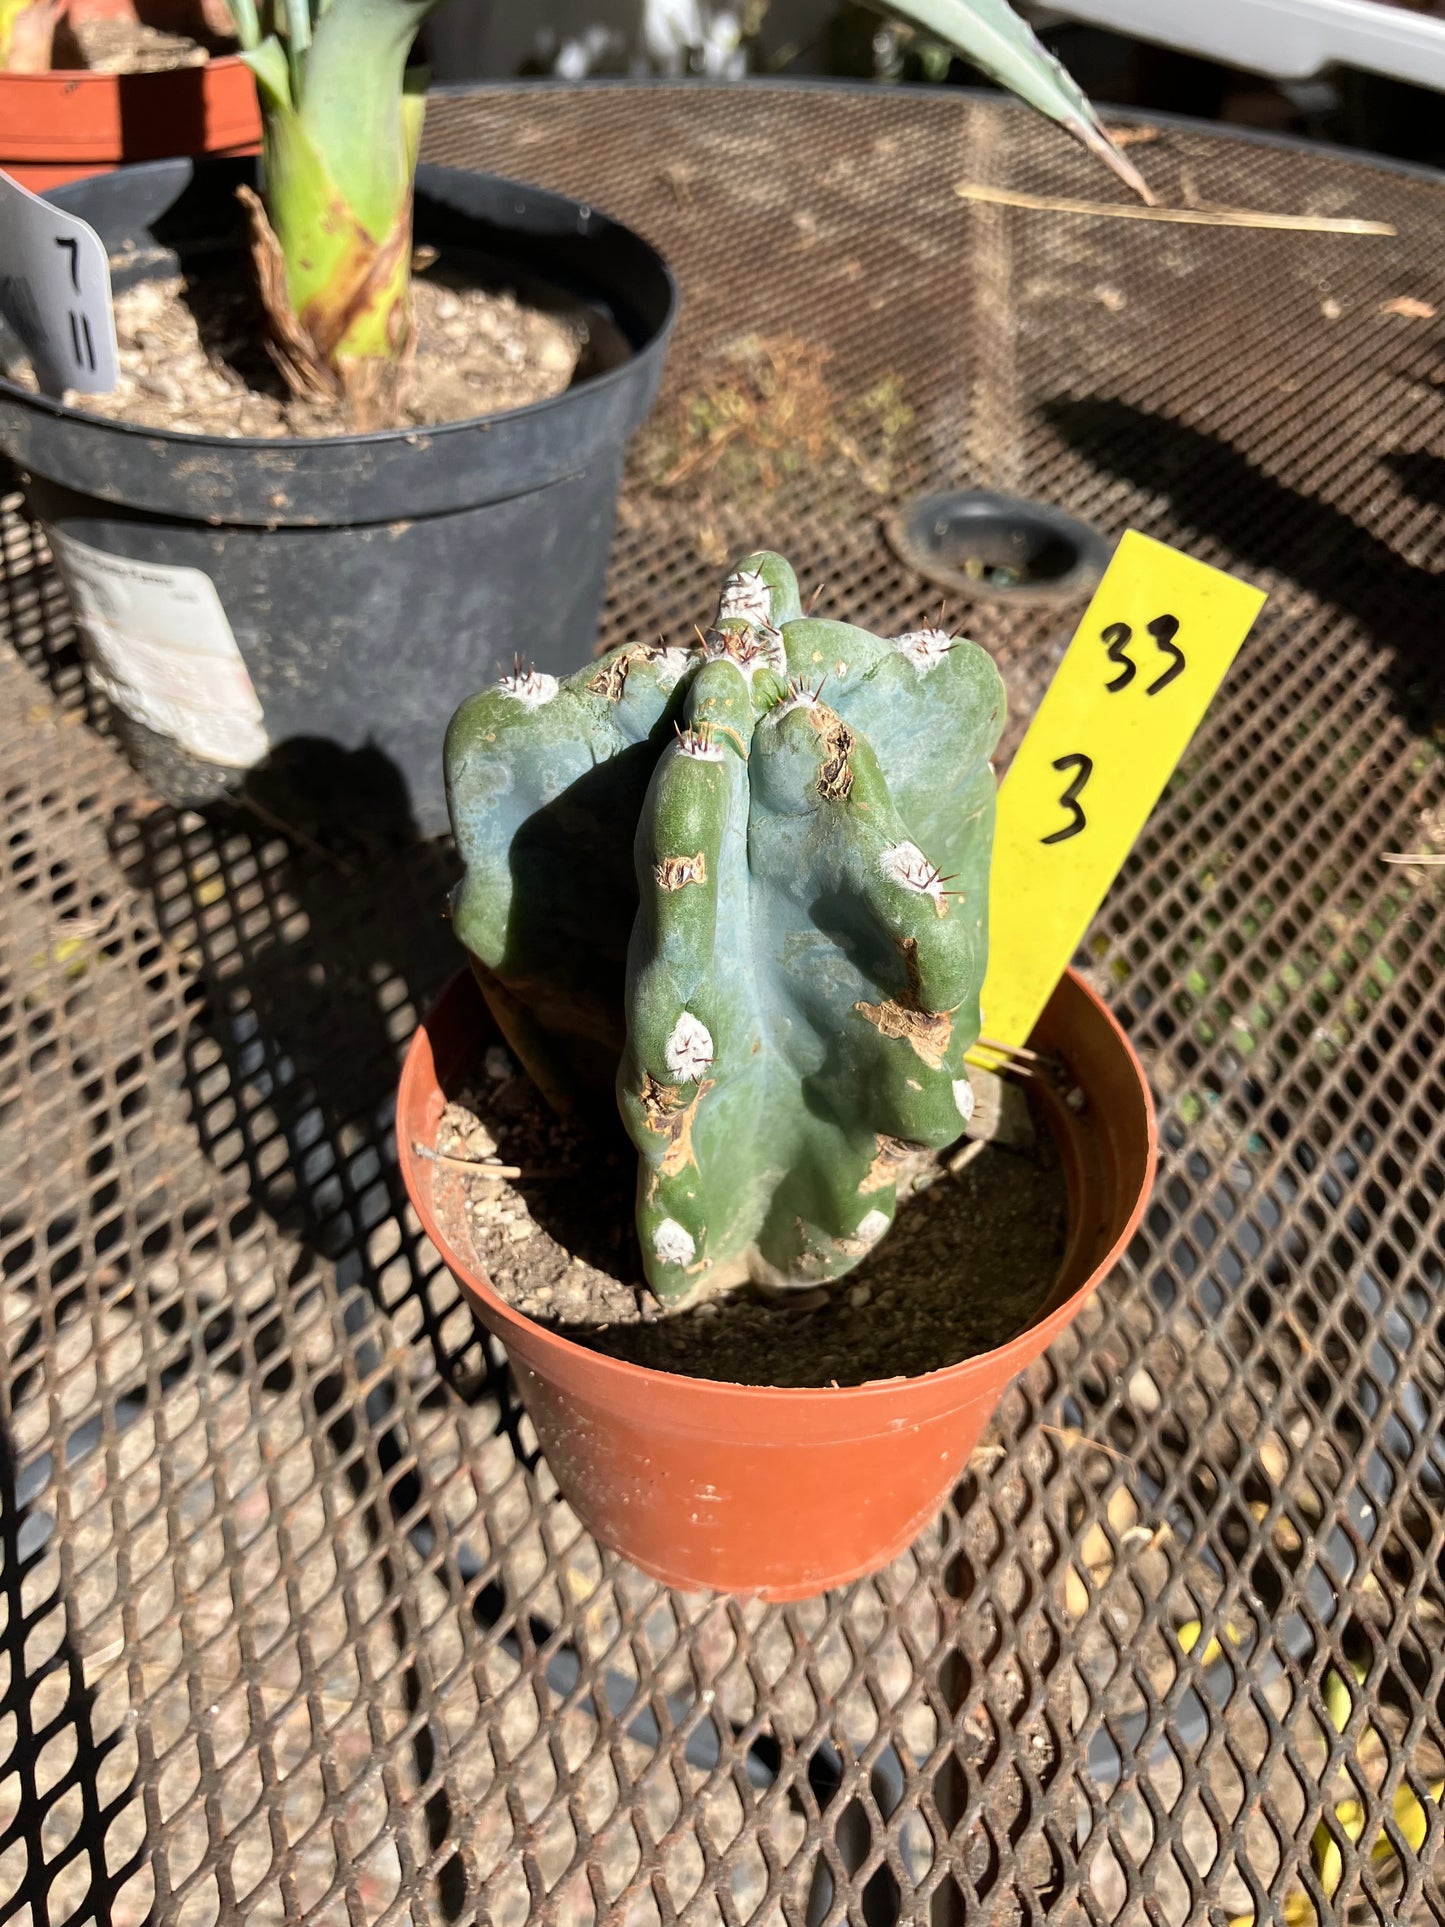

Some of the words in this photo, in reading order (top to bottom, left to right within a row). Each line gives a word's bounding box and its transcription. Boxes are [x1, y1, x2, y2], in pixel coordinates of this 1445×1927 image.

[55, 236, 82, 296] 7
[1100, 613, 1186, 697] 33
[1039, 752, 1094, 845] 3
